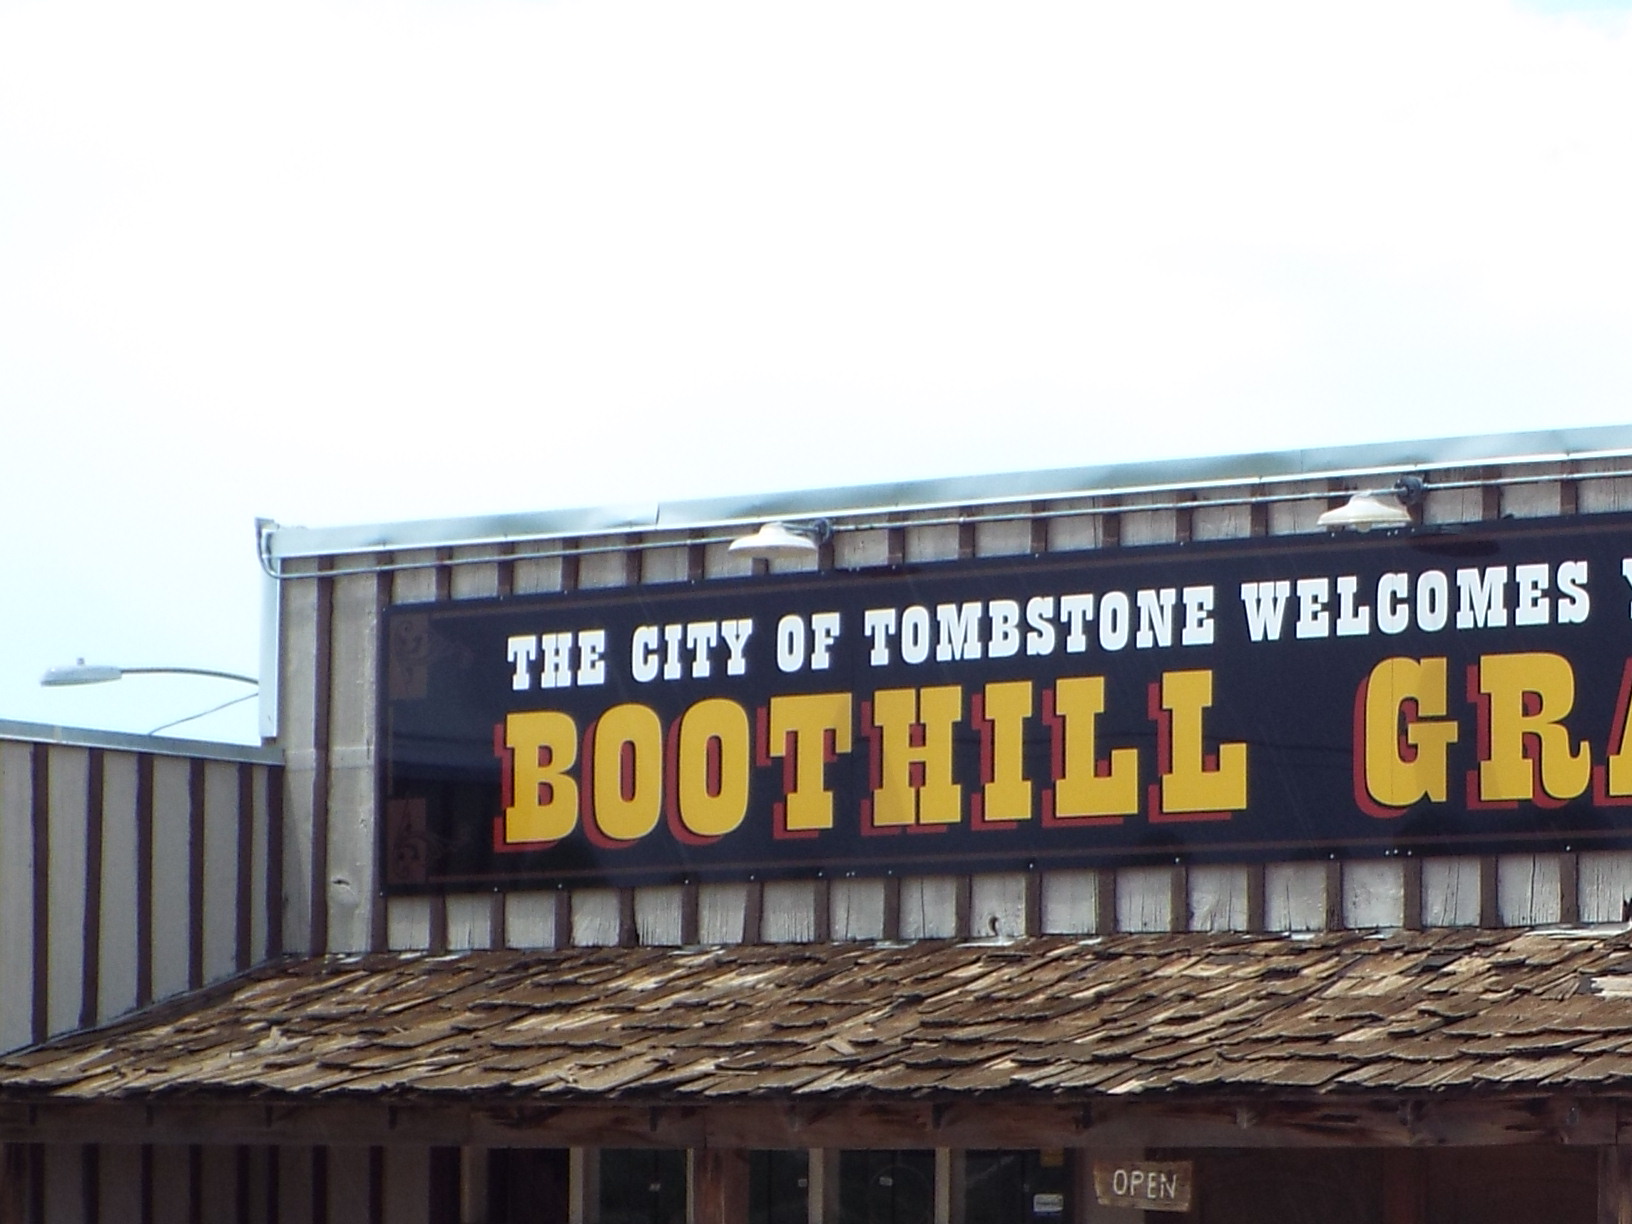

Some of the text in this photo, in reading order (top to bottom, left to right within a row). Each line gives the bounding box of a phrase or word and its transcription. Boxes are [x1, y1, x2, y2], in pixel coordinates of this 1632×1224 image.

[507, 629, 607, 691] THE
[631, 618, 754, 683] CITY
[776, 612, 842, 673] OF
[864, 585, 1216, 668] TOMBSTONE
[1241, 560, 1591, 643] WELCOMES
[496, 668, 1248, 850] BOOTHILL
[1112, 1168, 1177, 1199] OPEN
